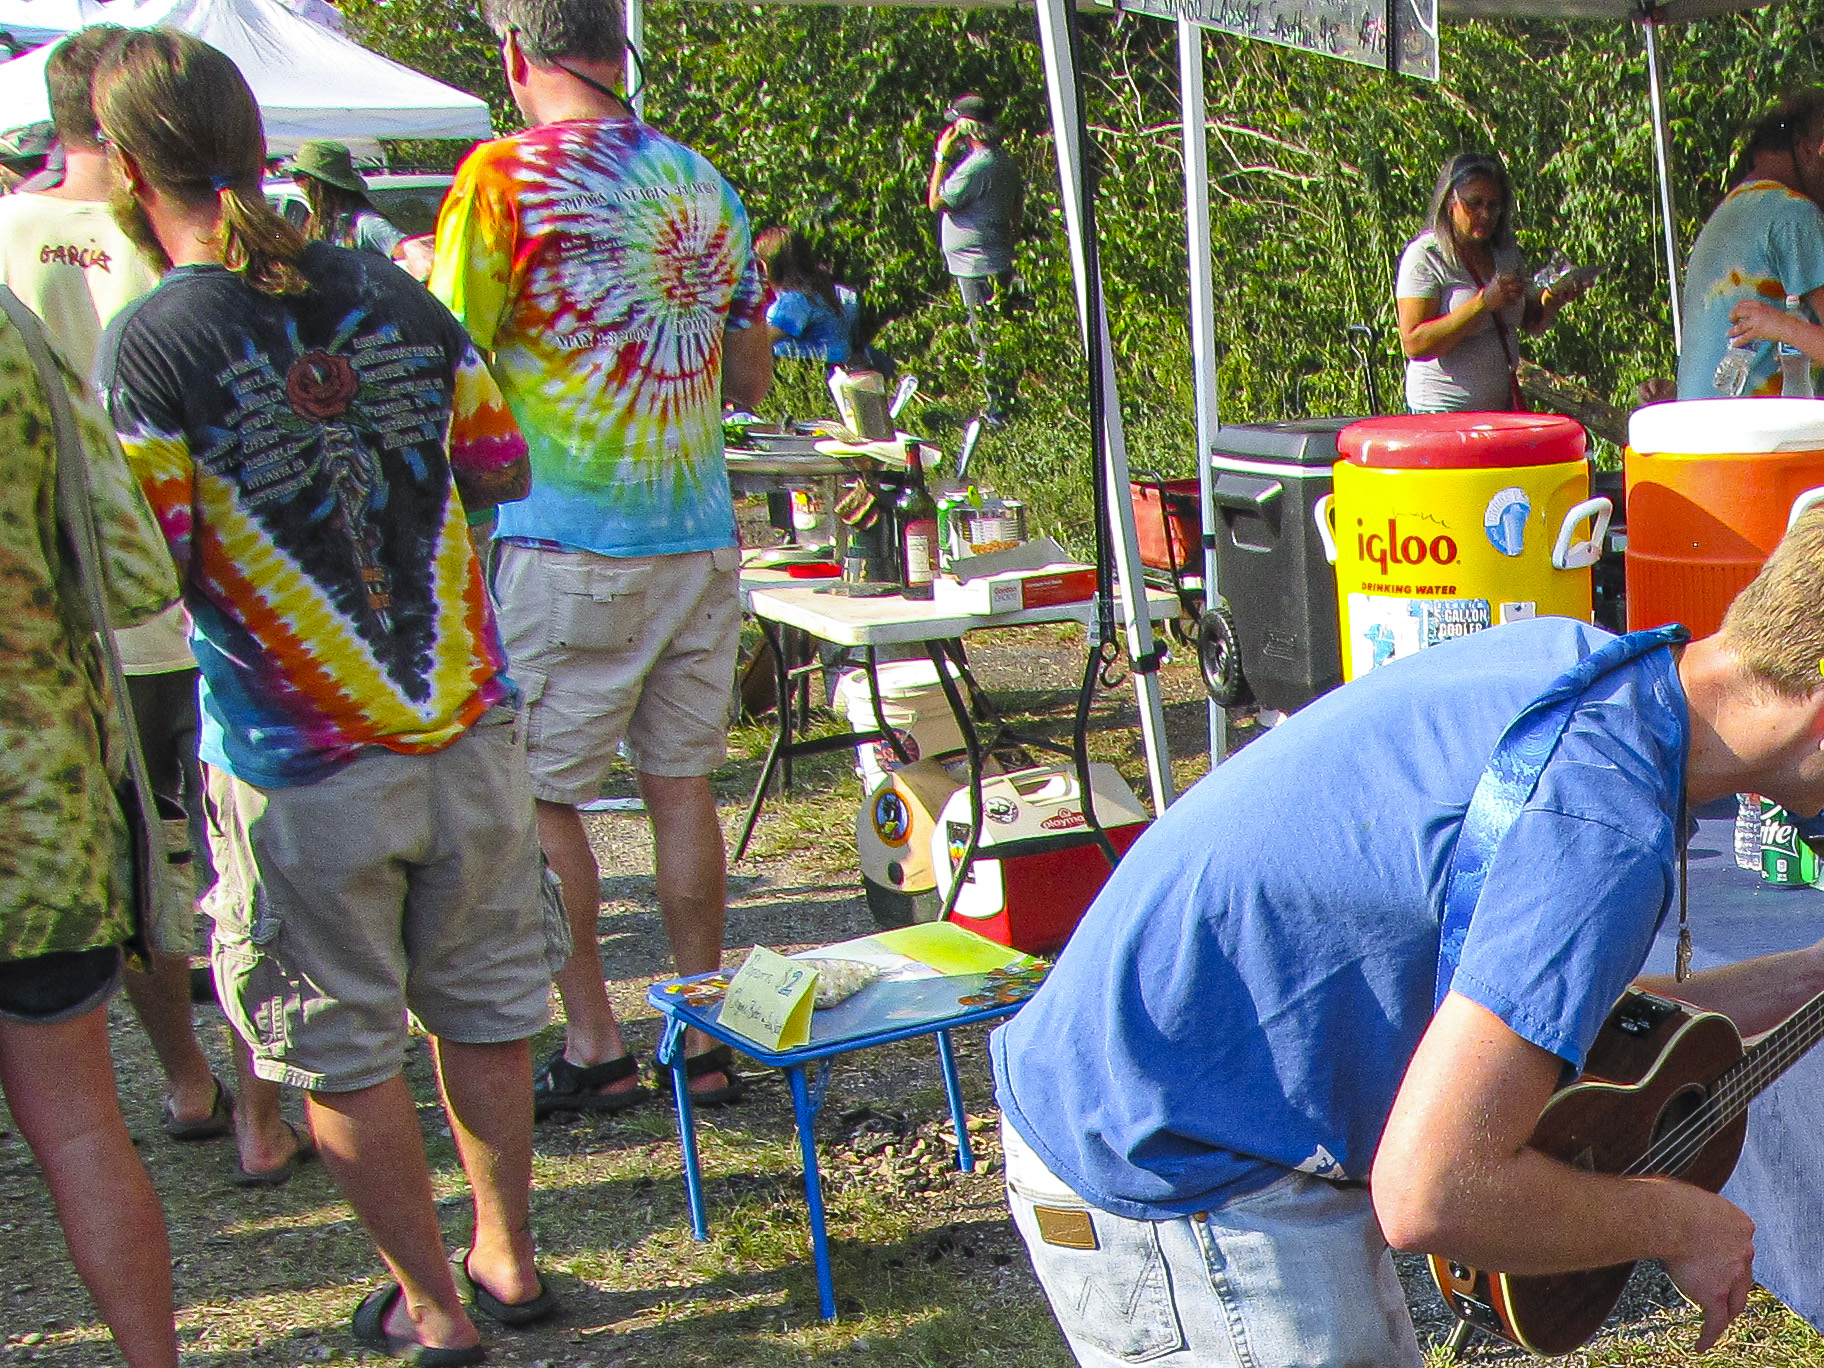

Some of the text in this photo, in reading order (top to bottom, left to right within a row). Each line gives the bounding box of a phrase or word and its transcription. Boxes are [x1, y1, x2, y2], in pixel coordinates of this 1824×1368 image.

[1357, 517, 1458, 575] igloo
[1362, 582, 1457, 595] DRINKING WATER
